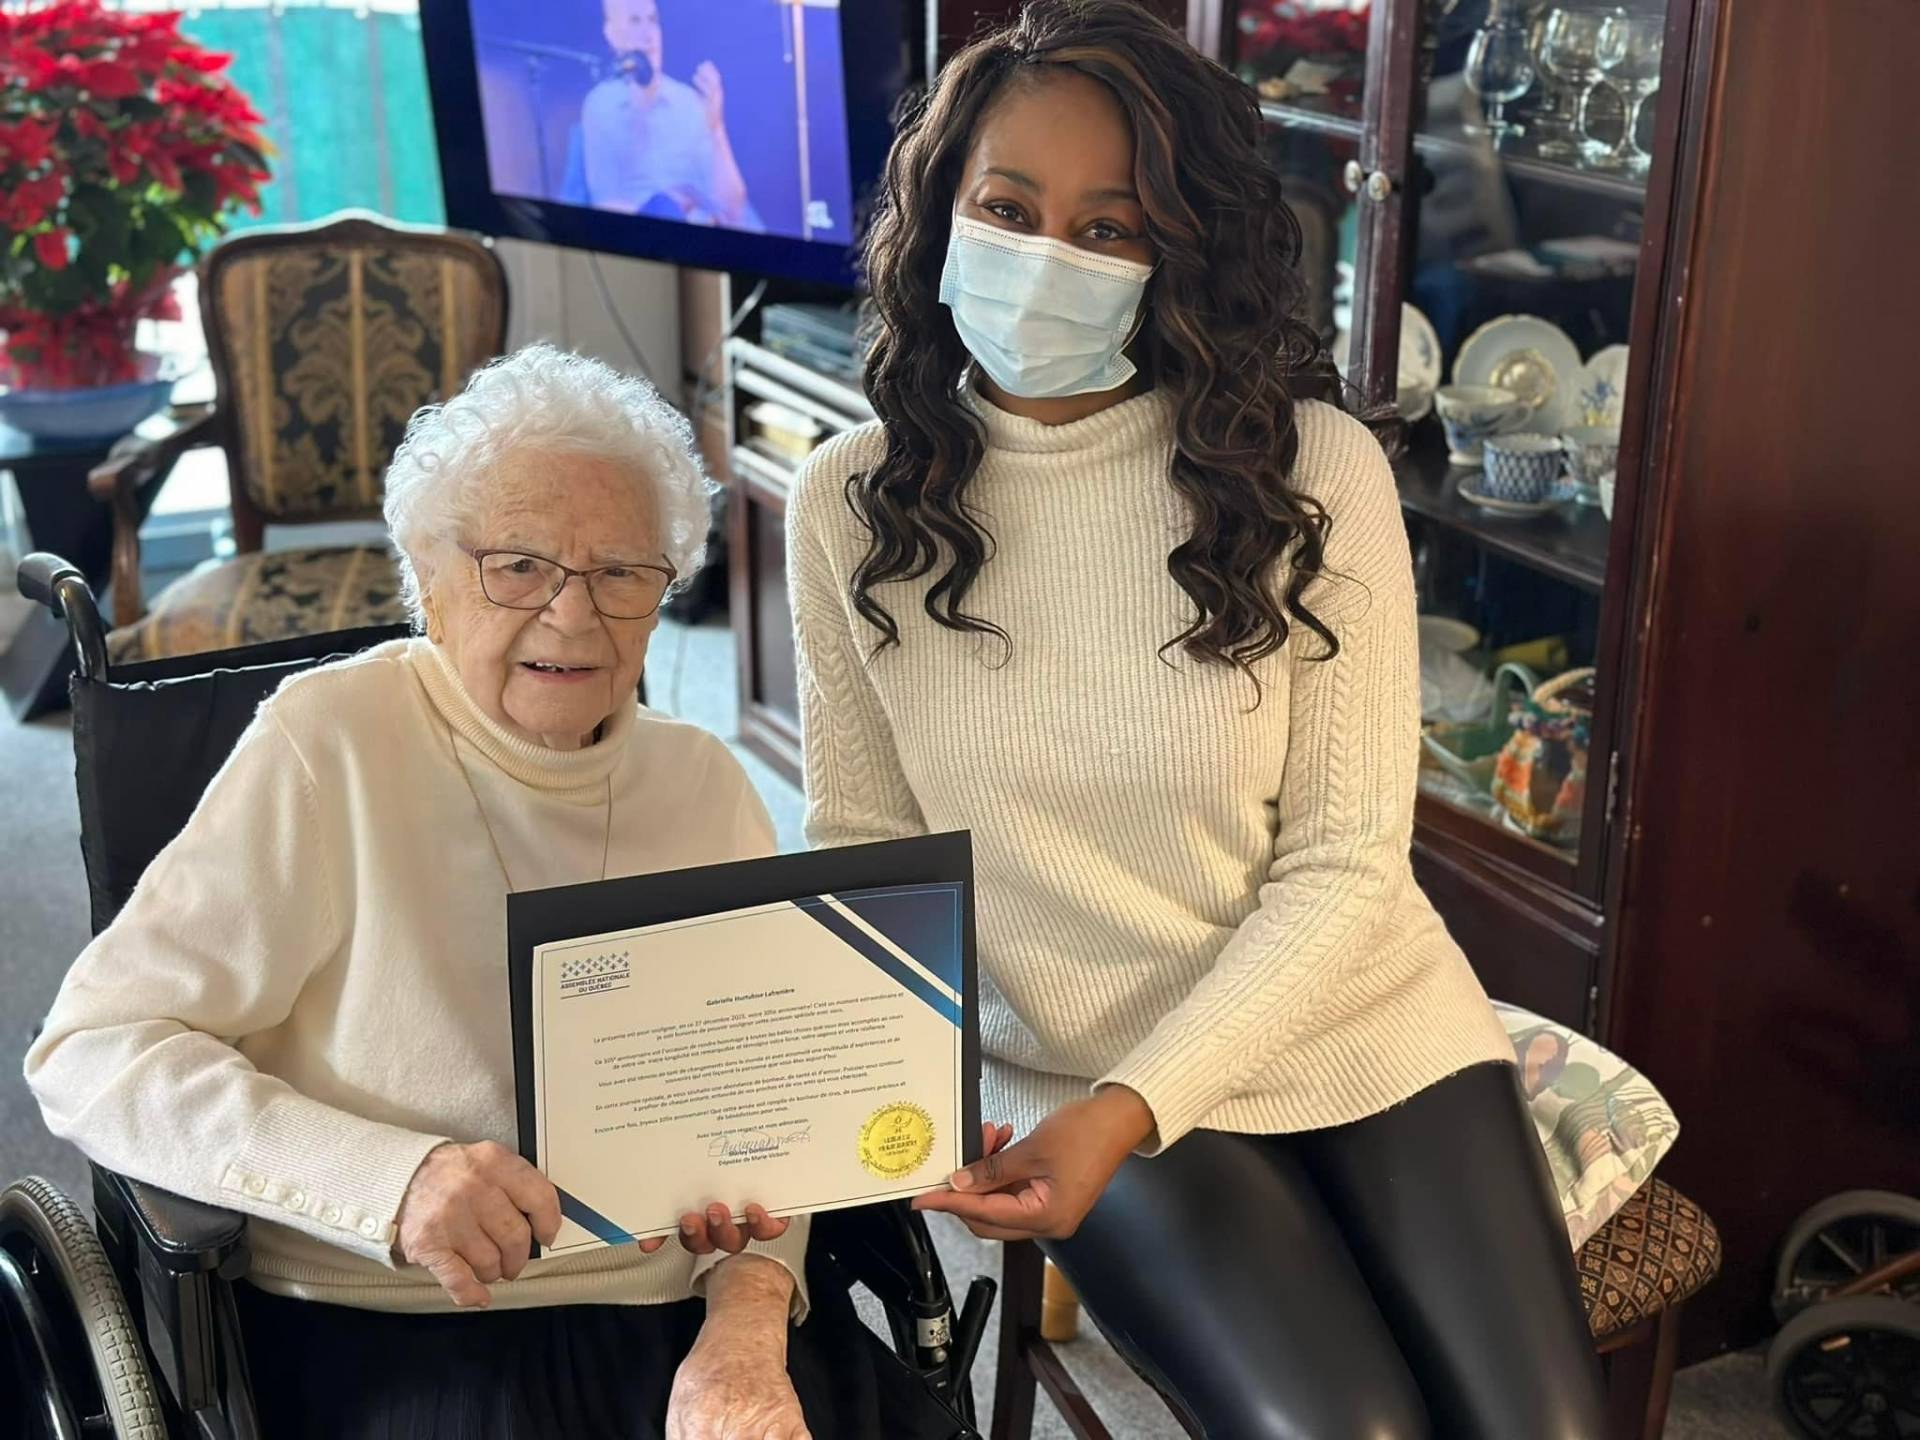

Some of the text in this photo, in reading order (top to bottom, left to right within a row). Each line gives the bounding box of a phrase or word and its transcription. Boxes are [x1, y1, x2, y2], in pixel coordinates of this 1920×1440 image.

[560, 972, 630, 989] ASSEMBLÉE NATIONALE
[588, 981, 612, 991] QUÉBEC
